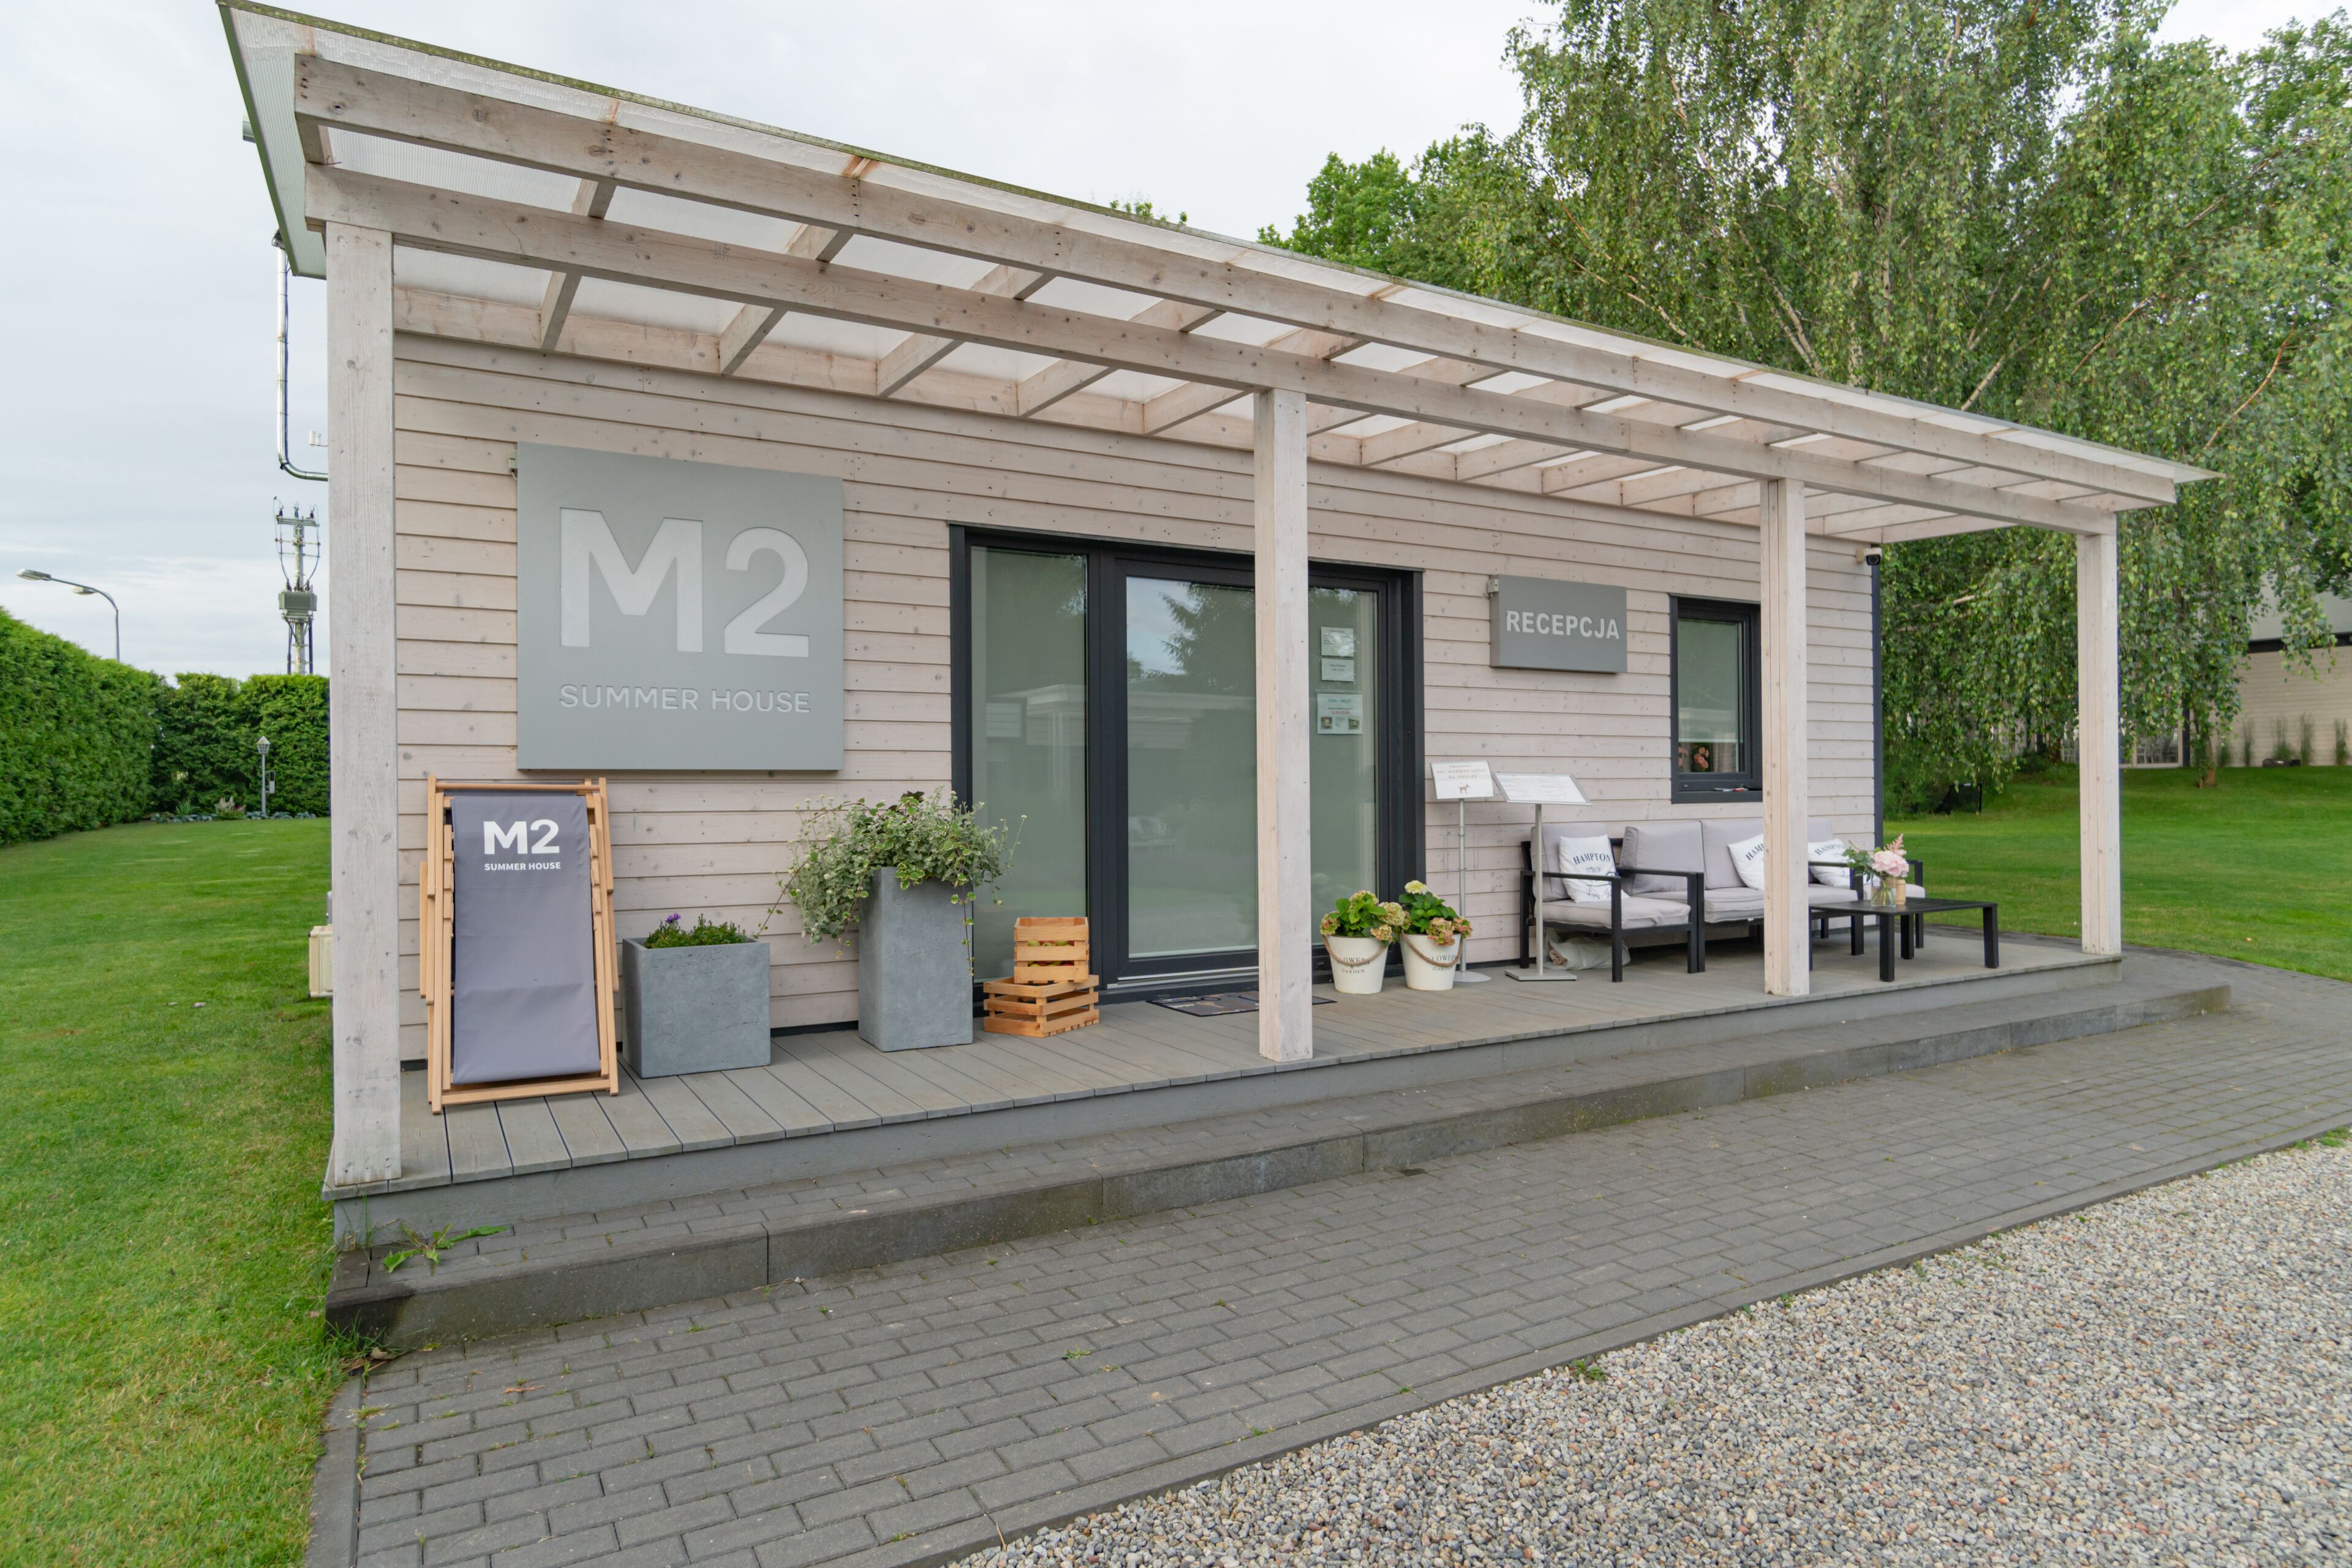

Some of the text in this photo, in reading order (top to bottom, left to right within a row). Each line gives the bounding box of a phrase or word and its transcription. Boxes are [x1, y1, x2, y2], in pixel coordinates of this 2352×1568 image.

[560, 507, 810, 657] M2
[1507, 610, 1620, 639] RECEPCJA
[559, 684, 810, 713] SUMMER HOUSE
[483, 819, 560, 854] M2
[1573, 853, 1611, 865] HAMPTON
